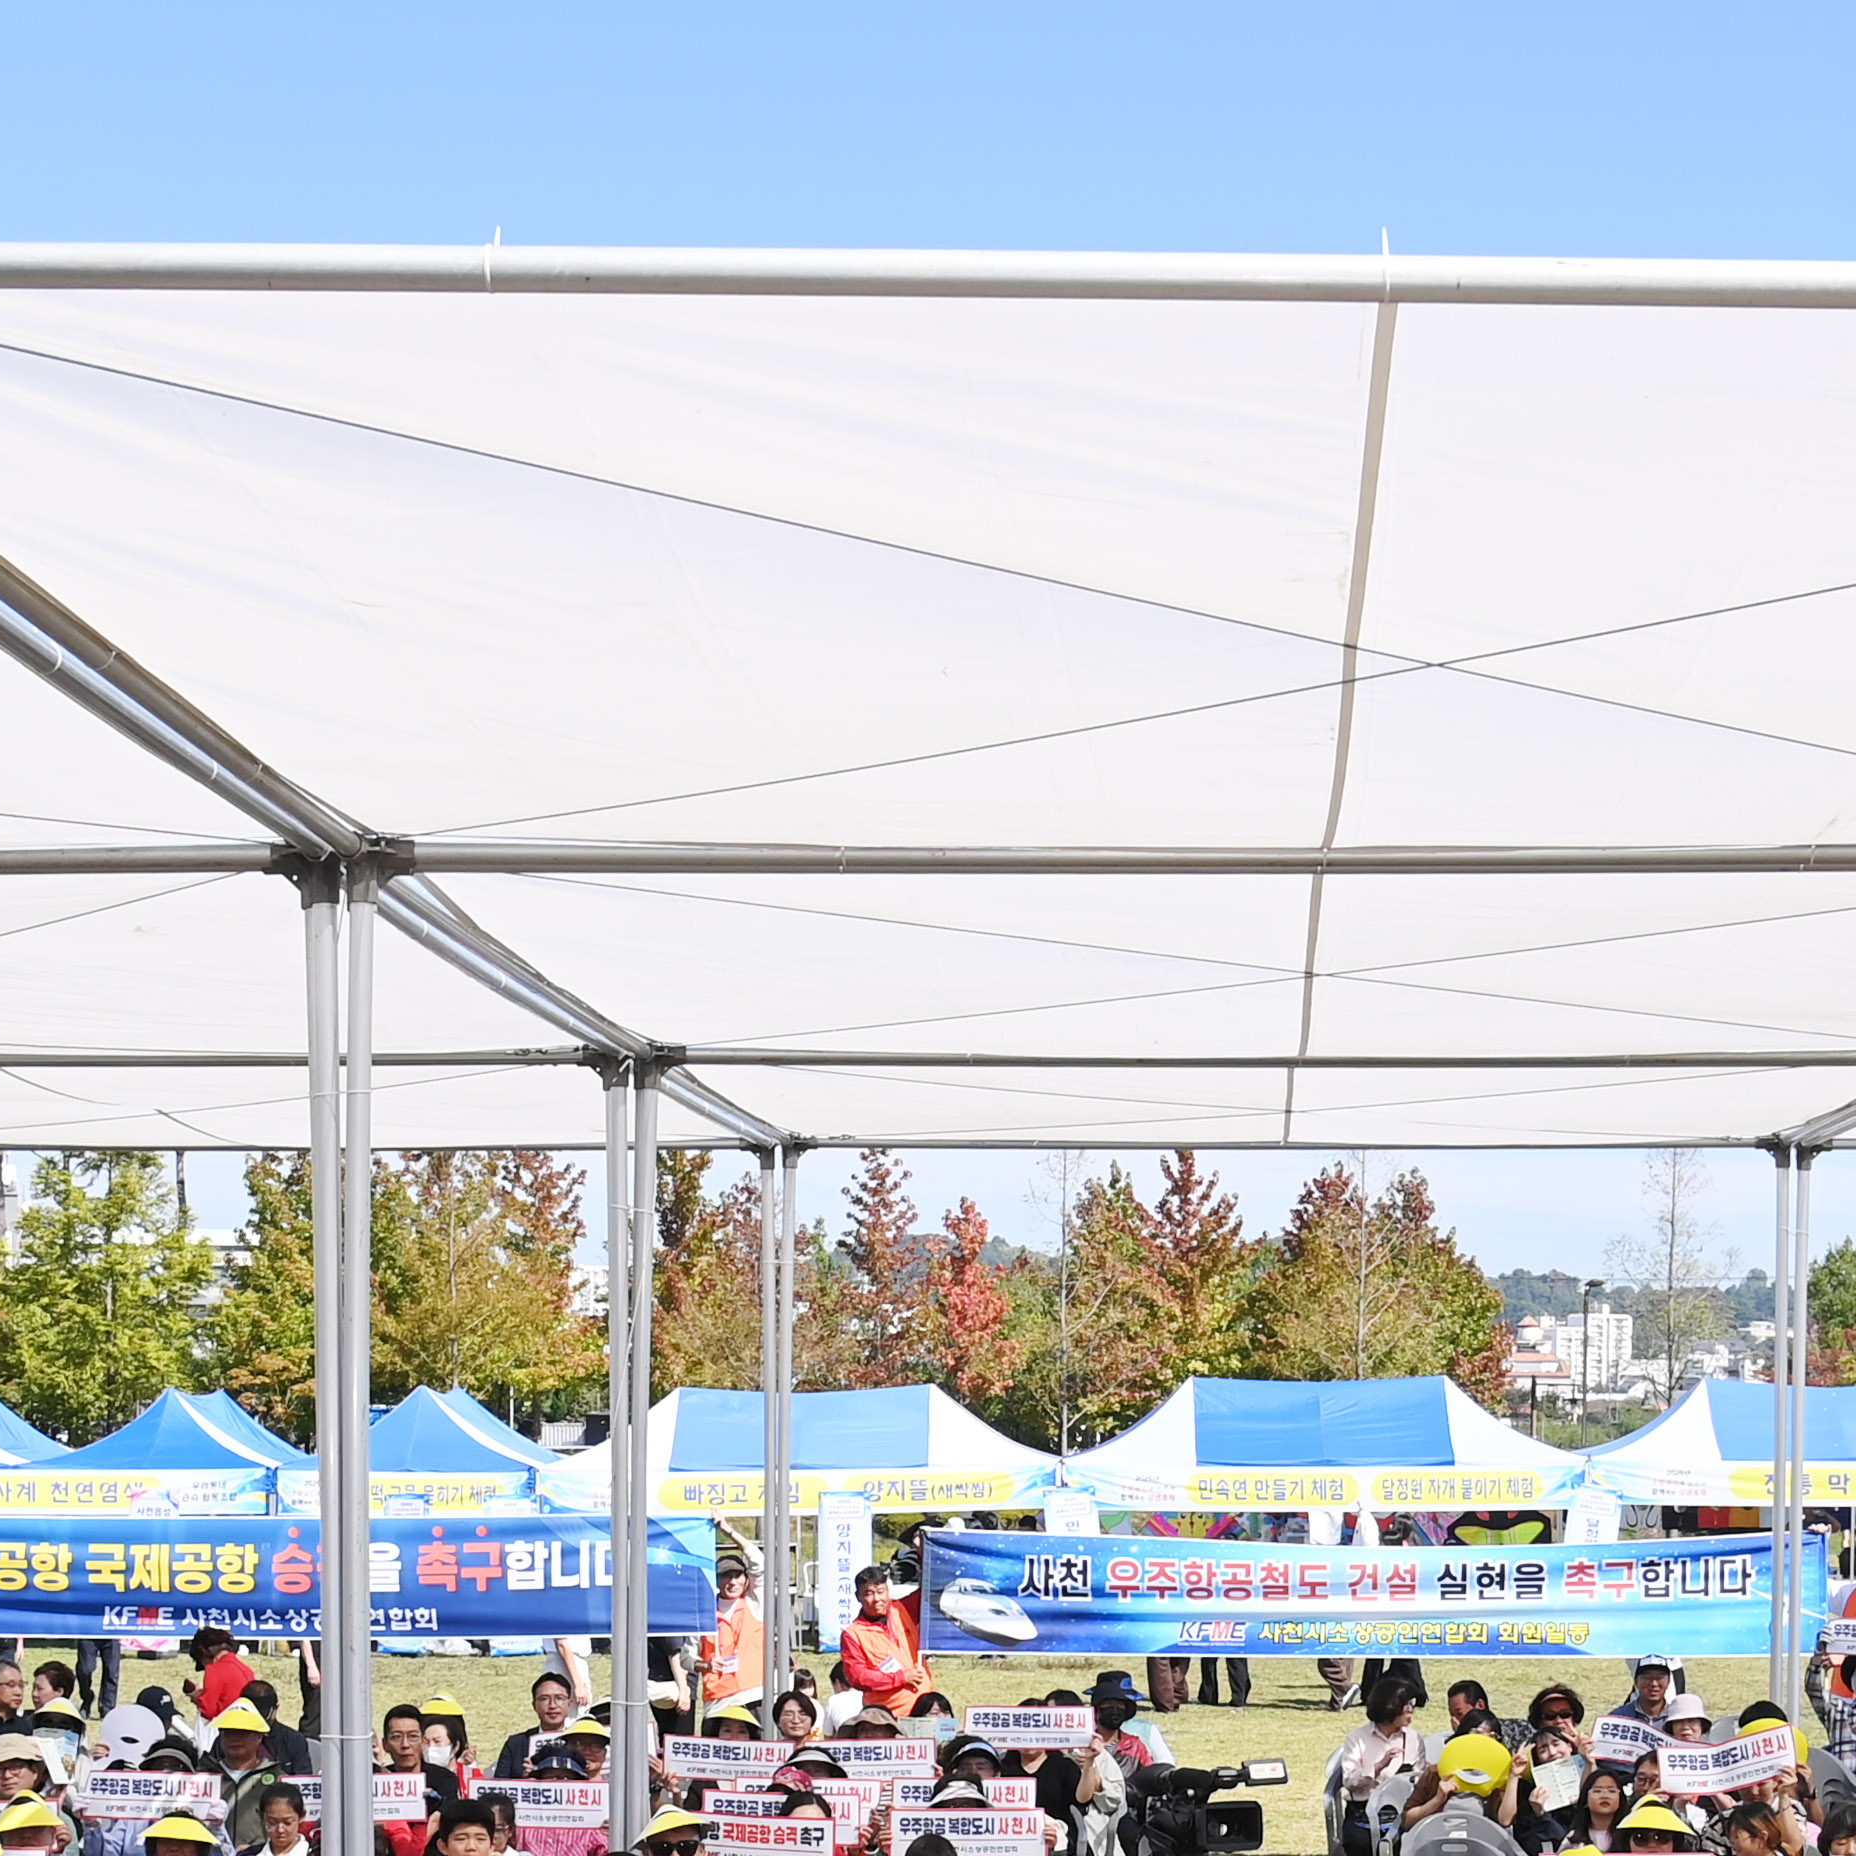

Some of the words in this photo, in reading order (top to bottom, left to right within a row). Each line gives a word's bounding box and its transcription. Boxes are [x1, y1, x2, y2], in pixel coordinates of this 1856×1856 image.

[684, 1483, 747, 1506] 빠징고
[1199, 1479, 1247, 1500] 민속연
[1255, 1478, 1304, 1500] 만들기
[1311, 1478, 1343, 1500] 체험
[1381, 1479, 1423, 1500] 달정원
[1428, 1479, 1454, 1500] 자개
[1458, 1477, 1503, 1500] 붙이기
[1507, 1476, 1534, 1499] 체험
[86, 1543, 259, 1593] 국제공항
[271, 1525, 401, 1593] 승을
[1018, 1555, 1091, 1600] 사천
[1105, 1556, 1330, 1602] 우주항공철도
[1347, 1562, 1419, 1600] 건설
[1436, 1559, 1546, 1600] 실현을
[1563, 1555, 1756, 1599] 촉구합니다
[103, 1606, 175, 1625] KFME
[1179, 1621, 1245, 1642] KFME
[1258, 1620, 1489, 1646] 사천시소상공인연합회
[1497, 1621, 1590, 1645] 회원일동
[973, 1713, 1010, 1728] 우주항공
[1013, 1713, 1050, 1728] 복합도시
[1050, 1713, 1085, 1728] 사천시
[90, 1778, 129, 1795] 우주항공
[132, 1779, 173, 1796] 복합도시
[176, 1780, 216, 1798] 사천시
